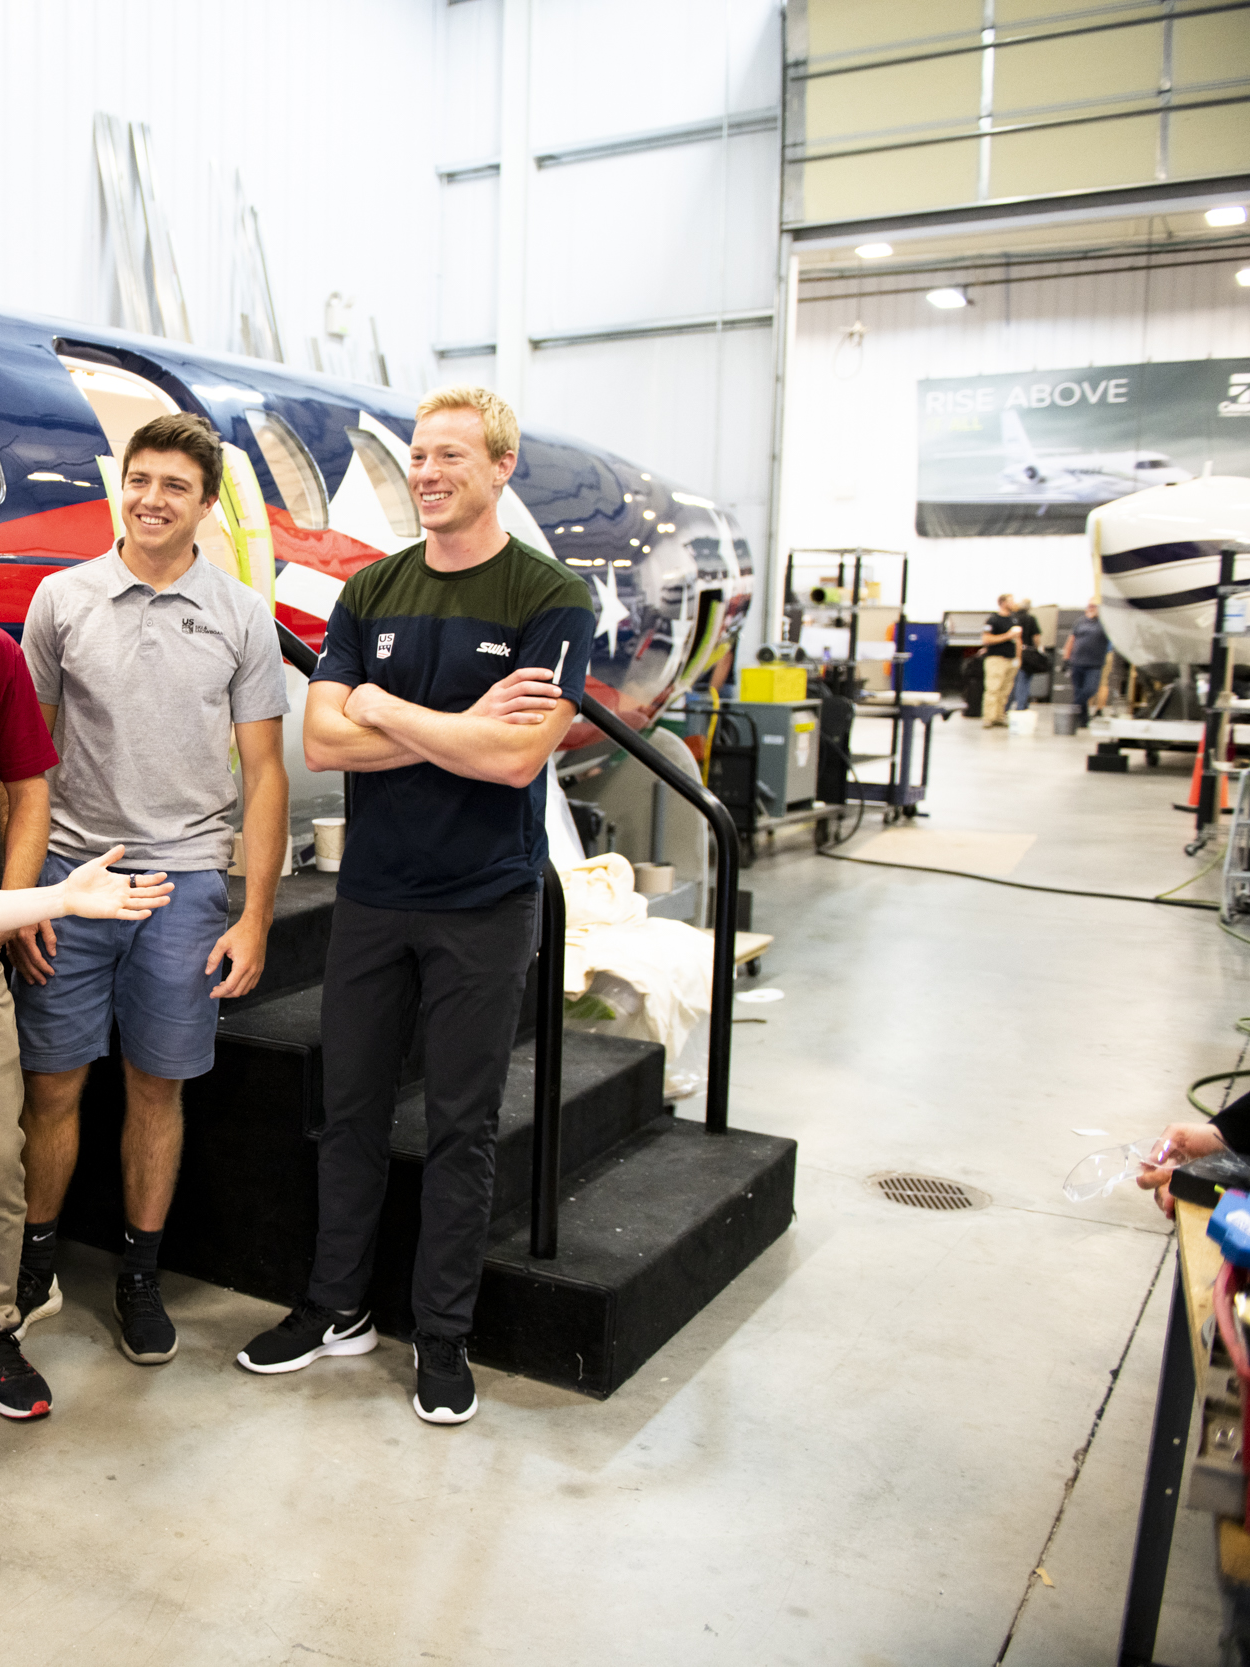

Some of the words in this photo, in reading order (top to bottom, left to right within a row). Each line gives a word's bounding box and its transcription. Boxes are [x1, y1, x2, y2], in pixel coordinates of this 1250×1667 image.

[925, 388, 996, 415] RISE
[1005, 378, 1130, 409] ABOVE
[379, 634, 393, 643] US
